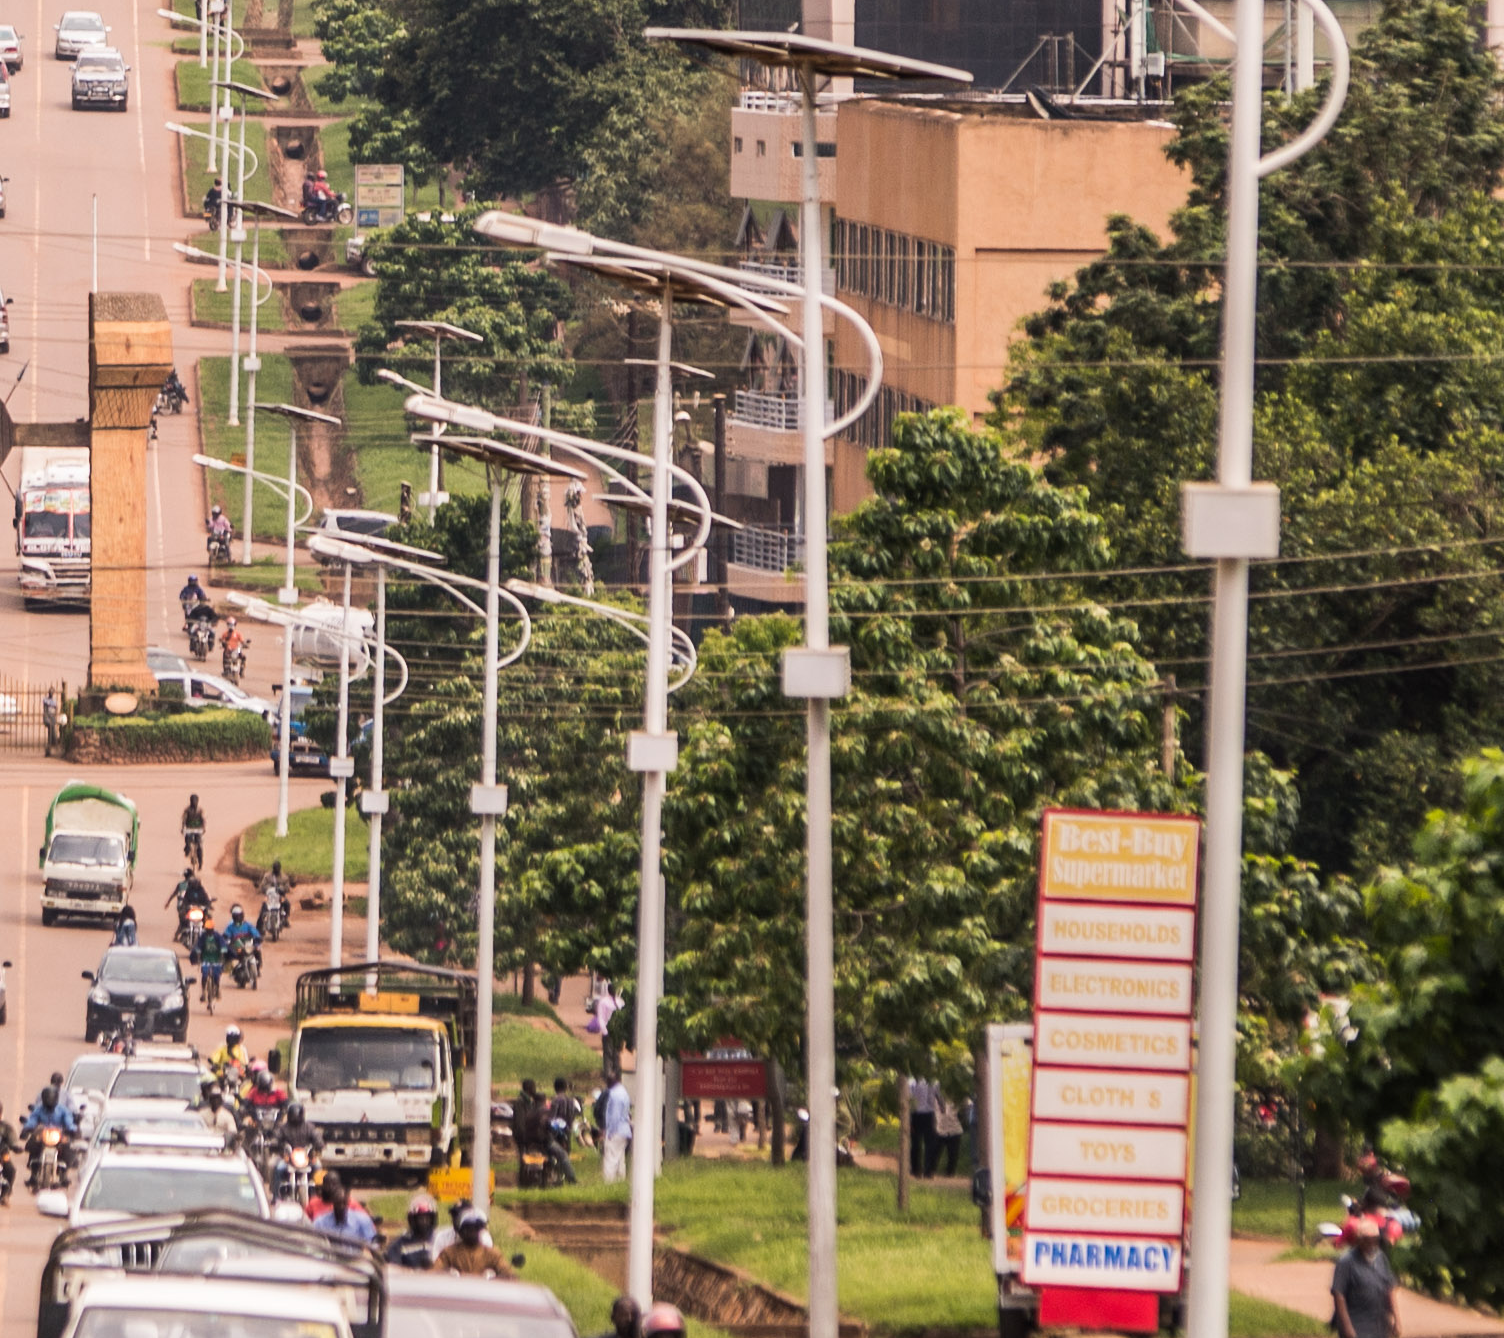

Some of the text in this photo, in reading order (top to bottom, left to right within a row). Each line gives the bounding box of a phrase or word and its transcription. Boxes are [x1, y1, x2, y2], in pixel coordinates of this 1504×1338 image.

[1058, 822, 1188, 861] Best-Buy
[1053, 855, 1188, 891] Supermarket
[1053, 919, 1182, 945] HOUSEHOLDS
[1050, 973, 1180, 1000] ELECTRONICS
[1049, 1029, 1179, 1056] COSMETICS
[1079, 1139, 1137, 1163] TOYS
[1041, 1194, 1170, 1220] GROCERIES
[1034, 1240, 1174, 1273] PHARMACY
